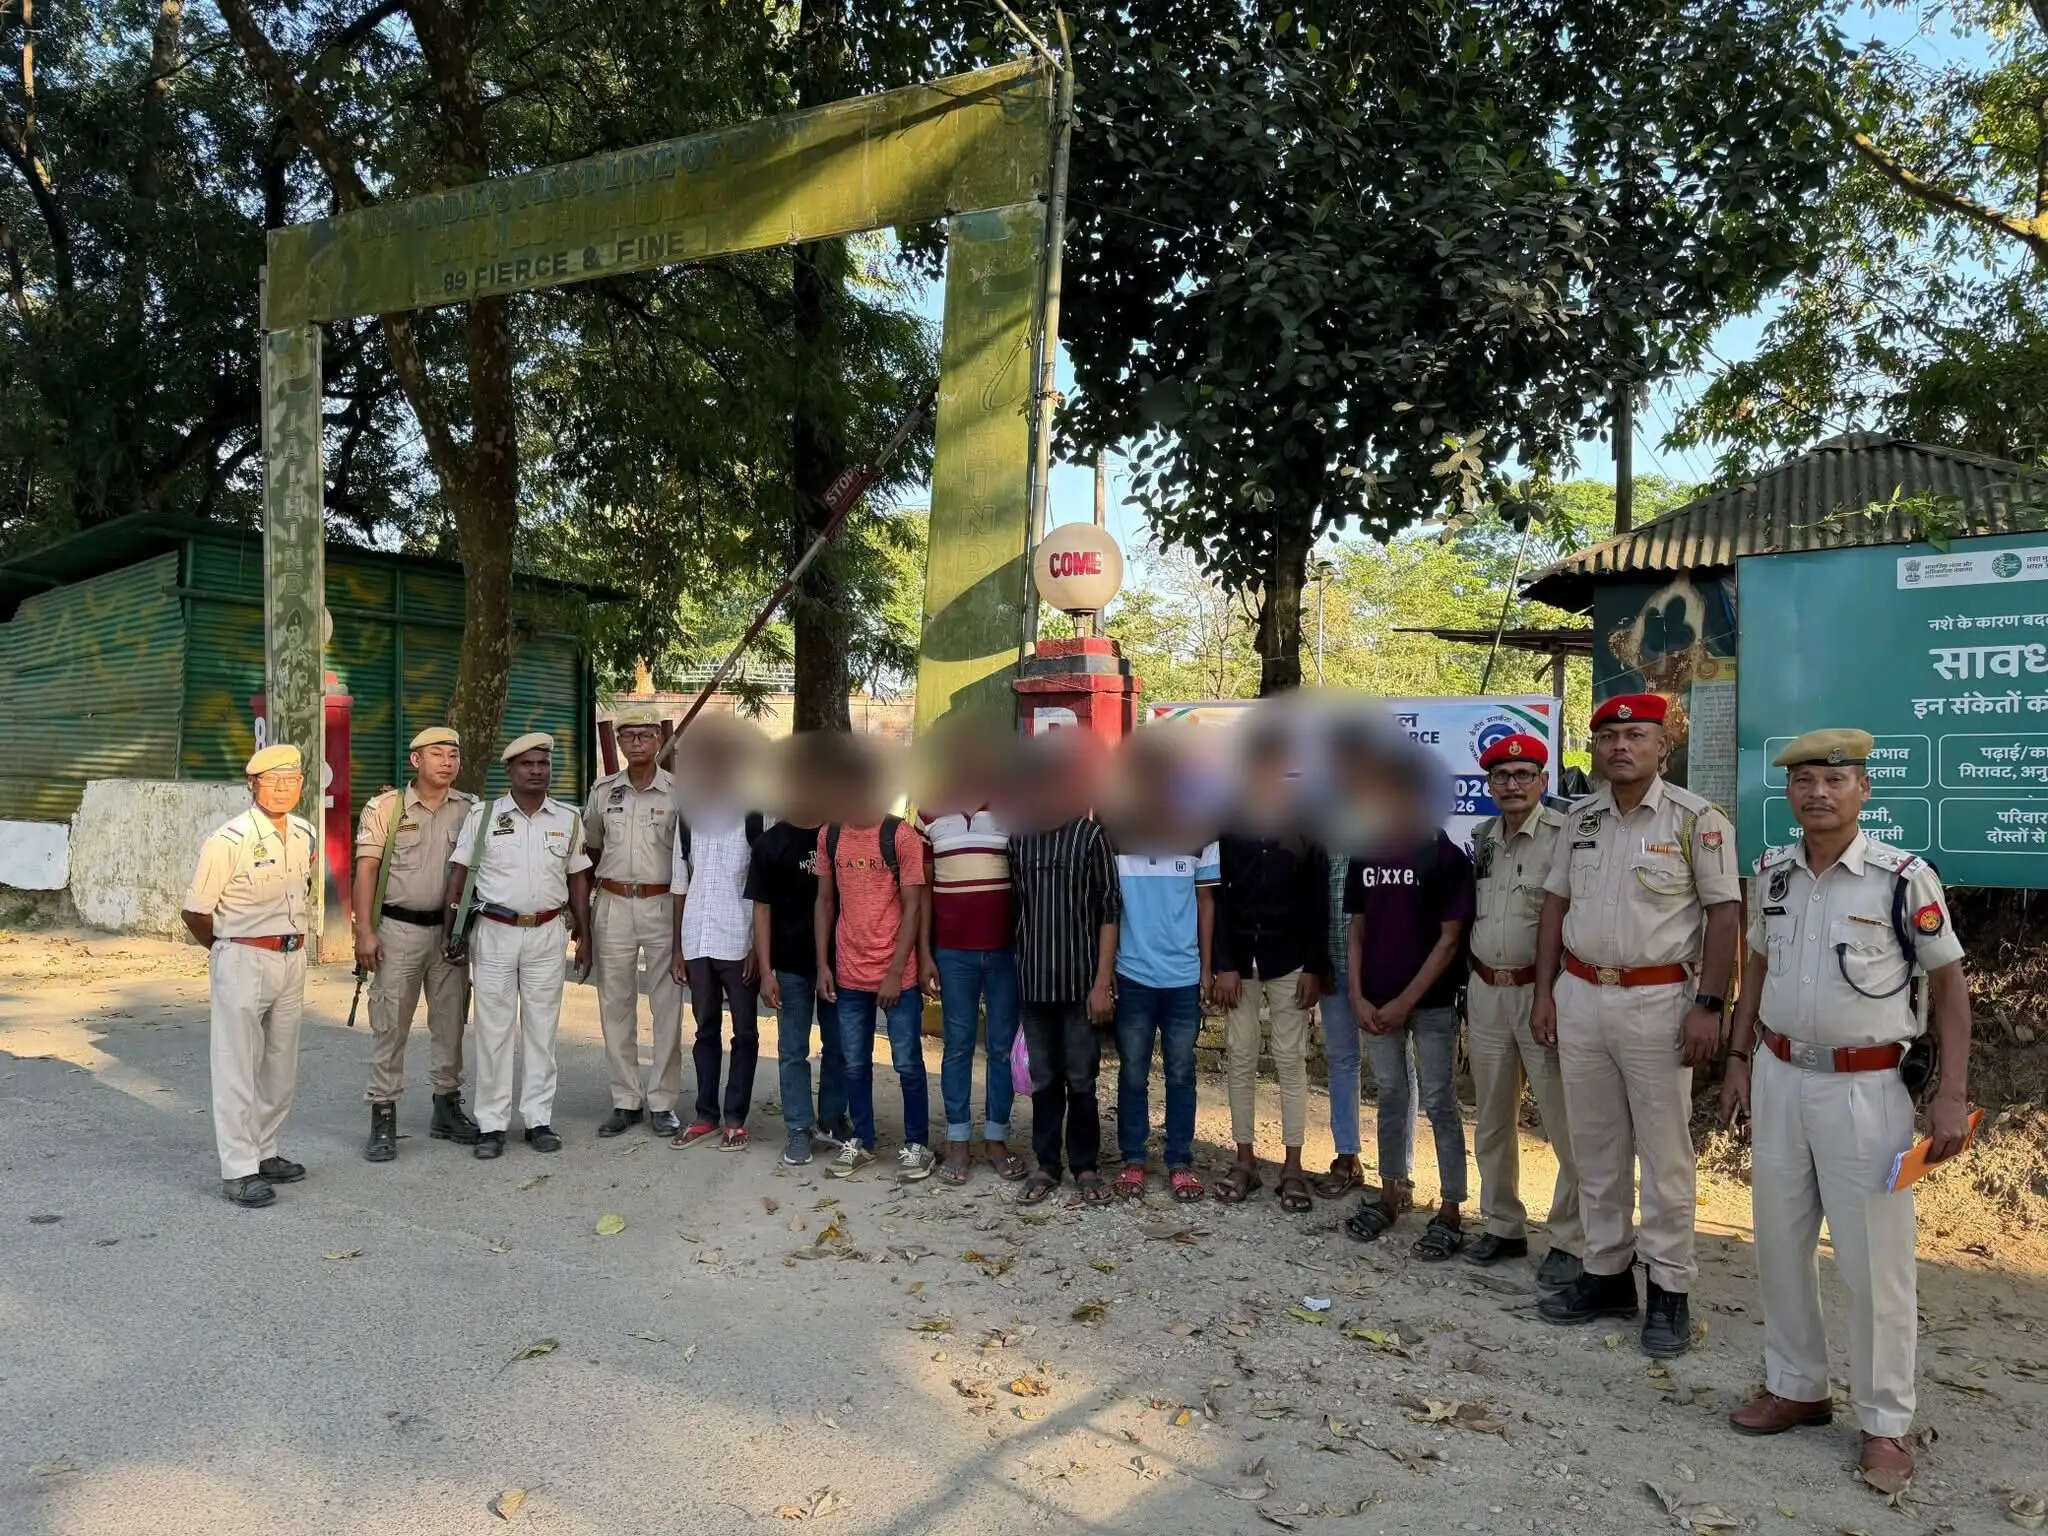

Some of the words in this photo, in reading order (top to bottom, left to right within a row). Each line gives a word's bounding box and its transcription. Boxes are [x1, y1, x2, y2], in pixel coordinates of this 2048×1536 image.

[443, 271, 467, 293] 89
[475, 251, 569, 287] FIERCE
[582, 247, 602, 270] &
[616, 230, 685, 263] FINE
[825, 467, 854, 505] STOP
[282, 495, 305, 596] HIND
[1049, 550, 1102, 577] COME
[1928, 616, 1953, 631] नशे
[1956, 614, 1972, 630] के
[1975, 614, 2020, 629] कारण
[1911, 697, 1947, 719] इन
[1950, 688, 2022, 715] संकेतों
[1408, 731, 1440, 744] RCE
[1867, 766, 1908, 779] दलाव
[1957, 762, 2018, 780] गिरावट,
[1996, 807, 2048, 824] परिवार
[1985, 826, 2029, 844] दोस्तों
[2030, 827, 2048, 843] से
[799, 858, 817, 870] NOR
